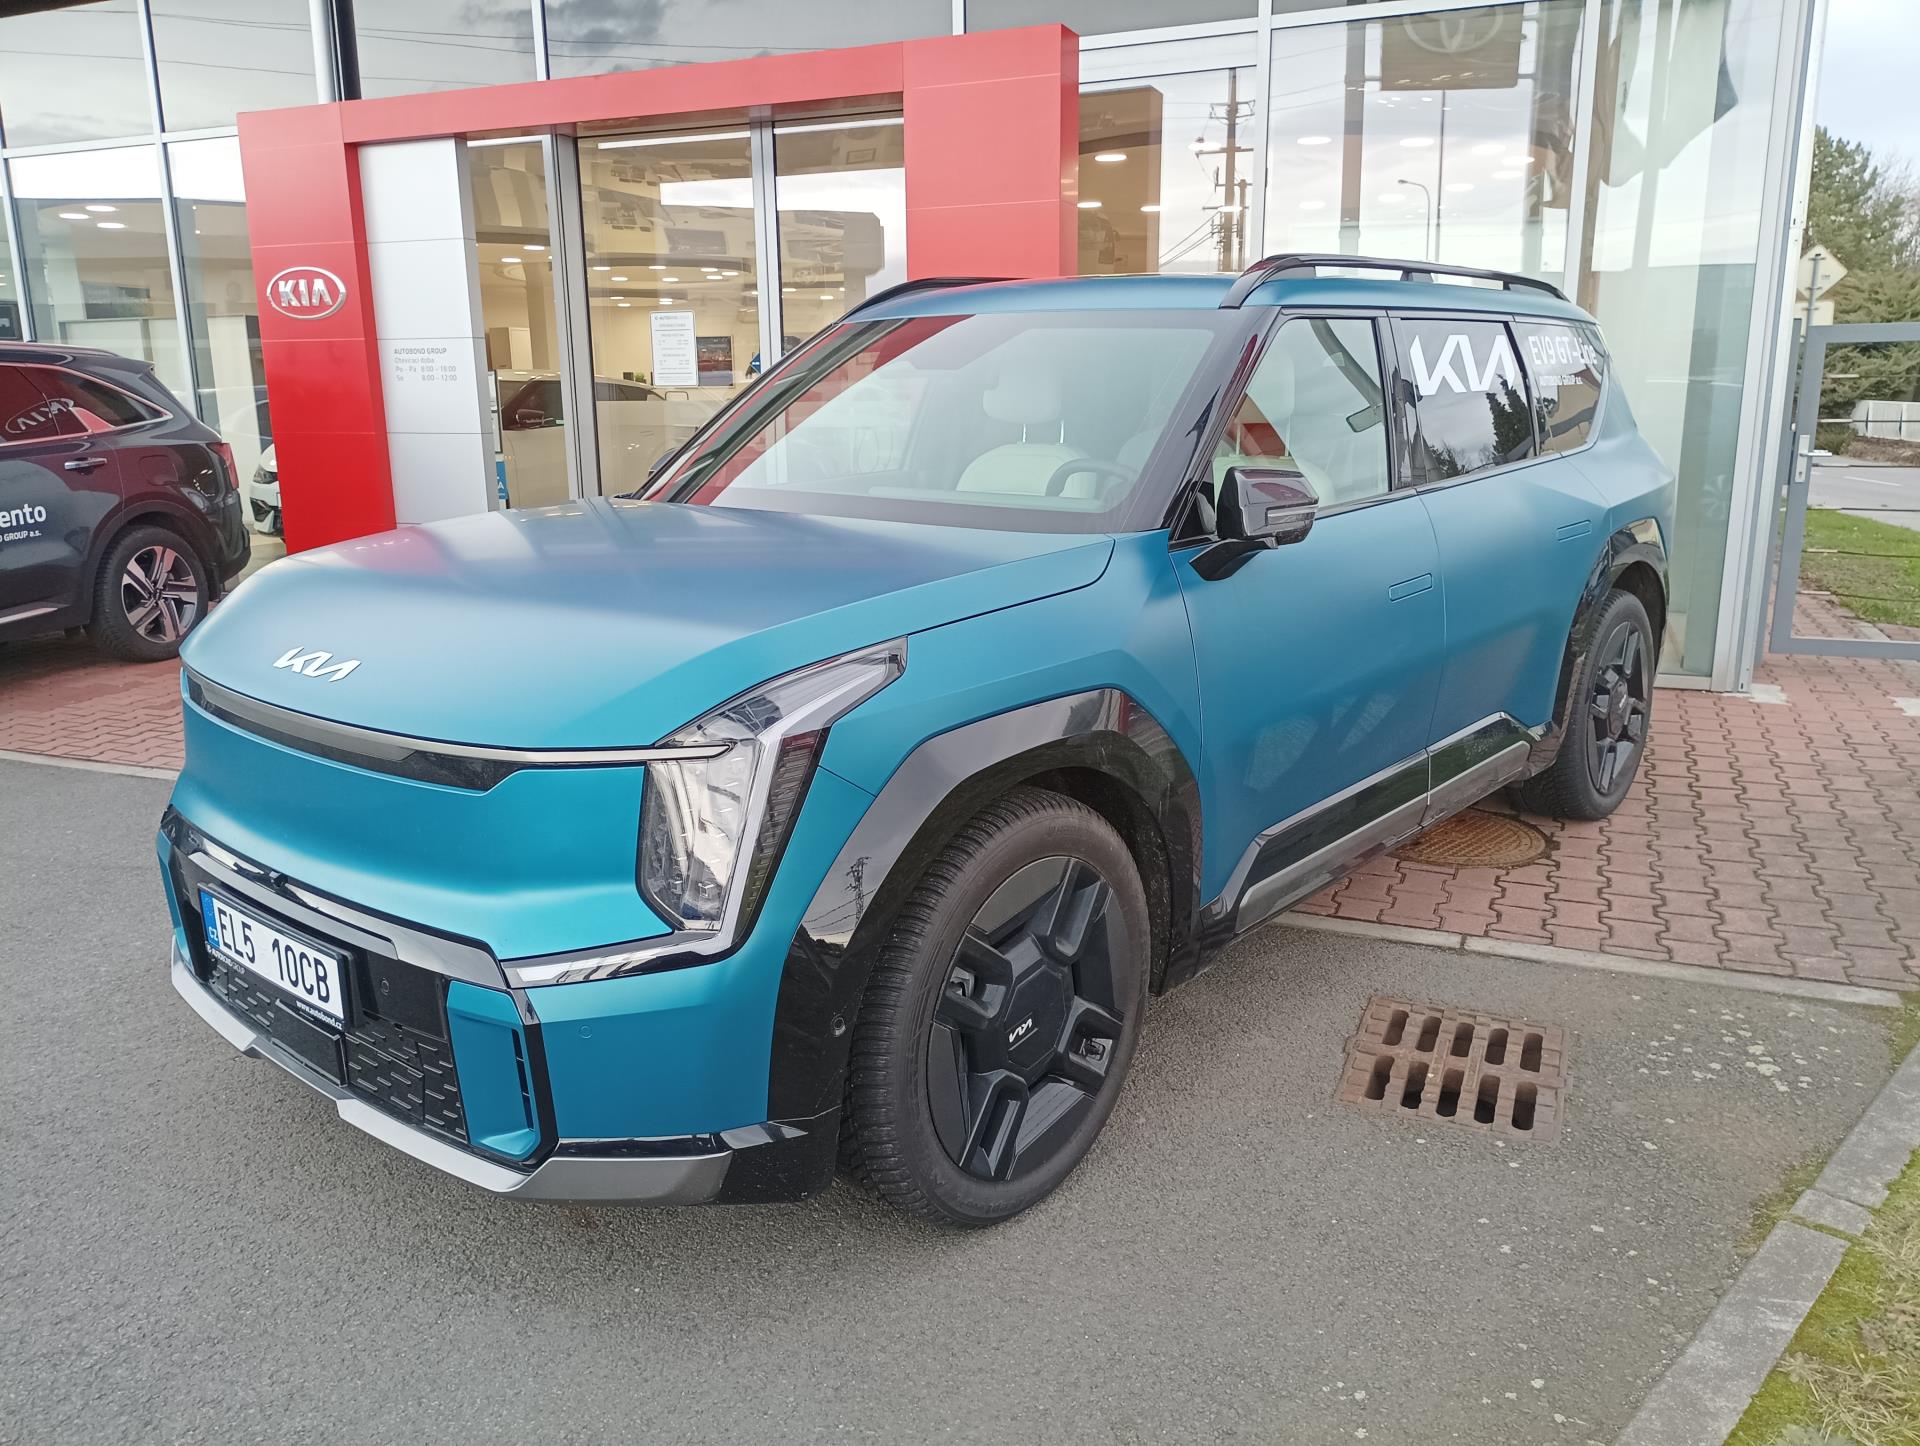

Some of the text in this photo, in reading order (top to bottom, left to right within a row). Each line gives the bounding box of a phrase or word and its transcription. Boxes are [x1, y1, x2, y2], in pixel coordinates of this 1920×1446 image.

[278, 279, 333, 307] KIA
[394, 347, 447, 355] AUTOBOND GROUP
[1528, 335, 1597, 365] EV9 GT-Line
[3, 530, 28, 542] GROUP
[208, 926, 219, 941] CZ
[218, 907, 330, 1003] EL5 10CB
